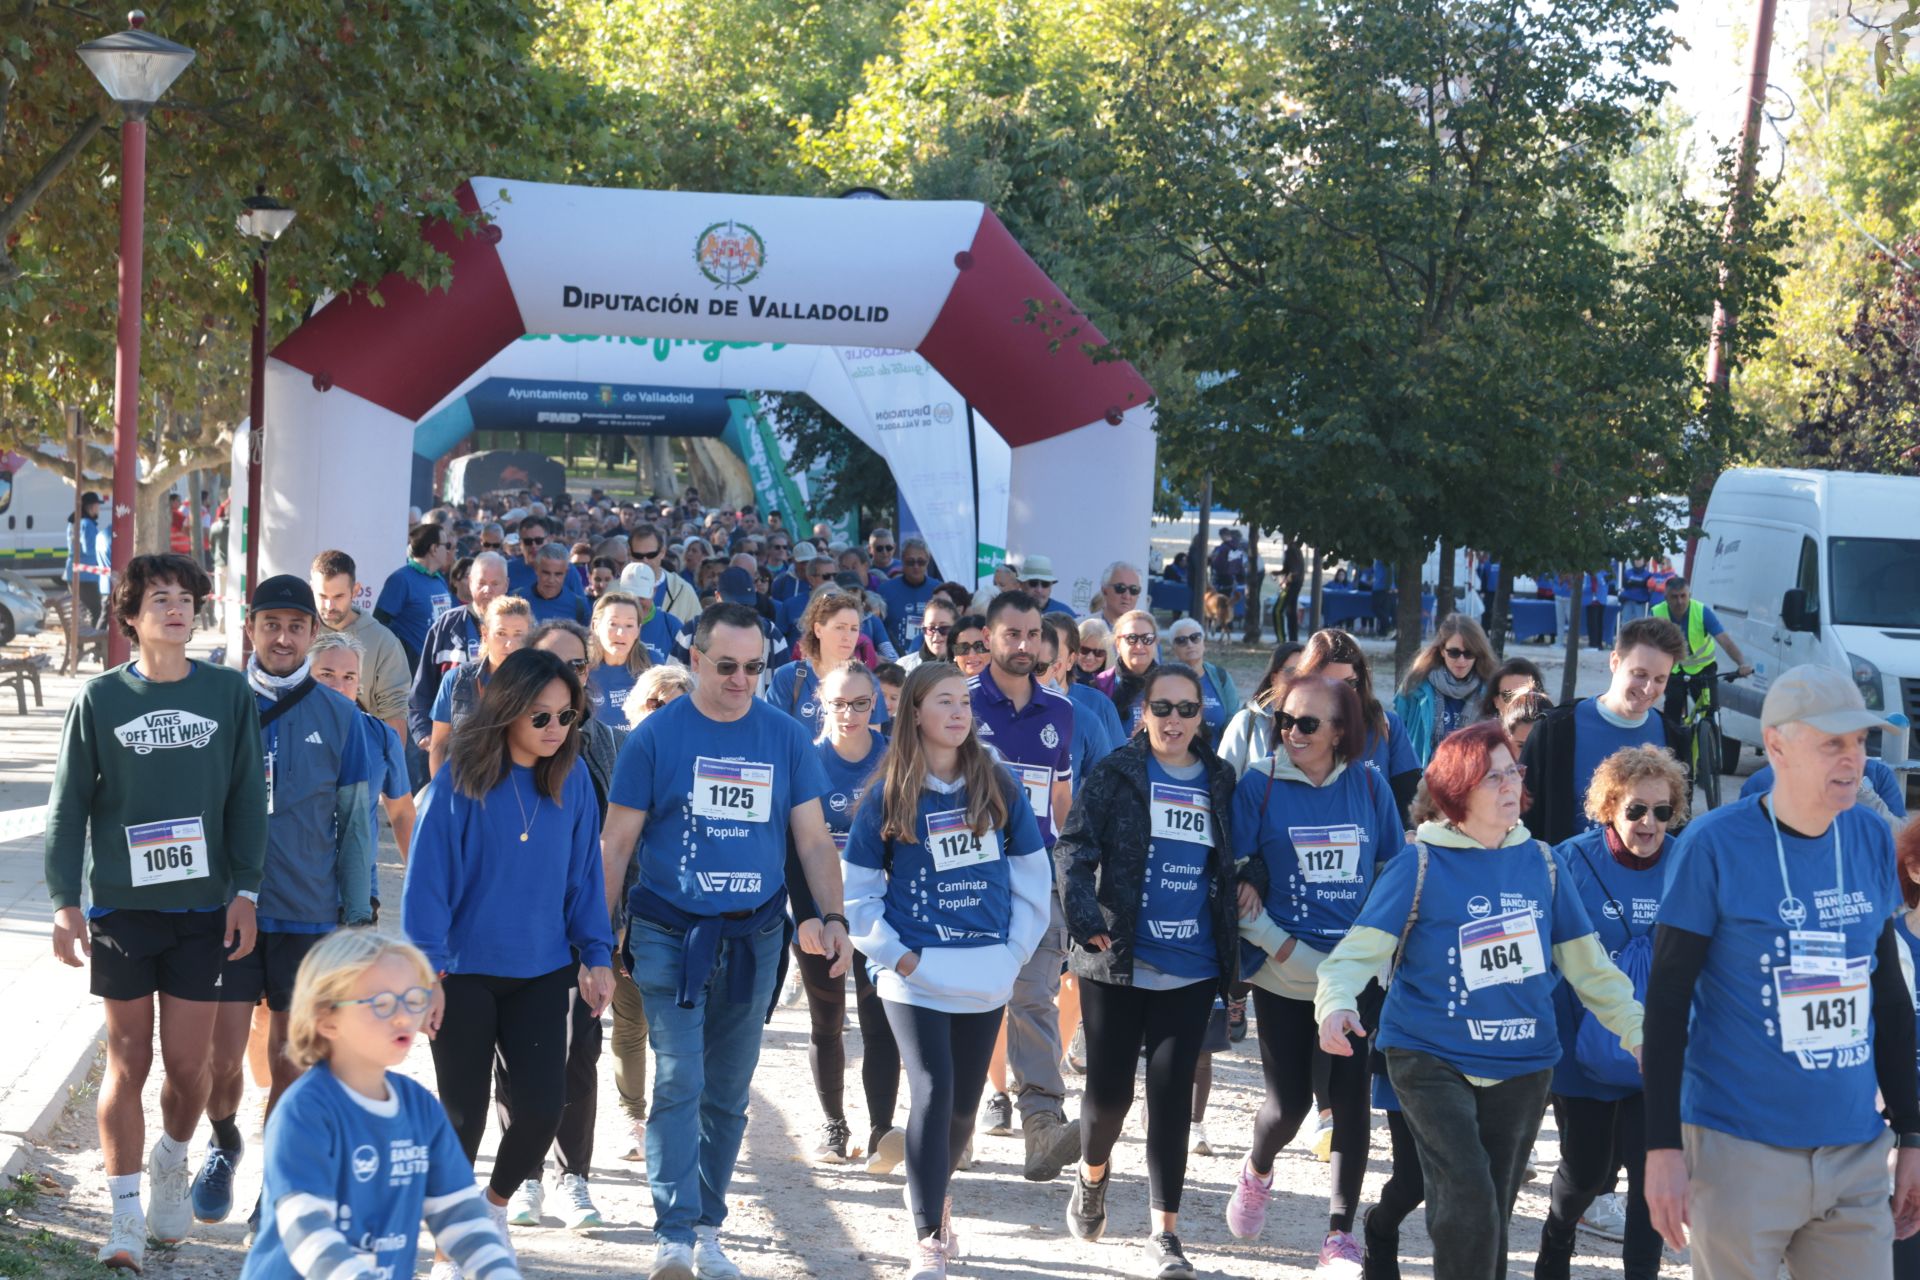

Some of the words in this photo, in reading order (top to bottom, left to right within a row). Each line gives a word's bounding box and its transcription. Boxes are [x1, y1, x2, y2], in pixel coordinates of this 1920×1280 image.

[563, 285, 698, 314] DIPUTACIÓN
[708, 299, 738, 316] DE
[748, 295, 889, 323] VALLADOLID
[508, 387, 588, 401] Ayuntamiento
[622, 391, 637, 402] de
[638, 392, 694, 404] Valladolid
[144, 712, 181, 728] VANS
[150, 726, 176, 743] THE
[709, 785, 754, 809] 1125
[1164, 808, 1204, 832] 1126
[706, 827, 750, 840] Popular
[939, 832, 982, 858] 1124
[143, 845, 193, 872] 1066
[1305, 849, 1343, 871] 1127
[729, 879, 761, 893] ULSA
[937, 880, 987, 893] Caminata
[939, 896, 981, 911] Popular
[1317, 889, 1357, 901] Popular
[1500, 898, 1528, 908] BANCO
[1528, 900, 1538, 909] DE
[1480, 942, 1523, 972] 464
[1802, 996, 1856, 1031] 1431
[1500, 1024, 1536, 1041] ULSA
